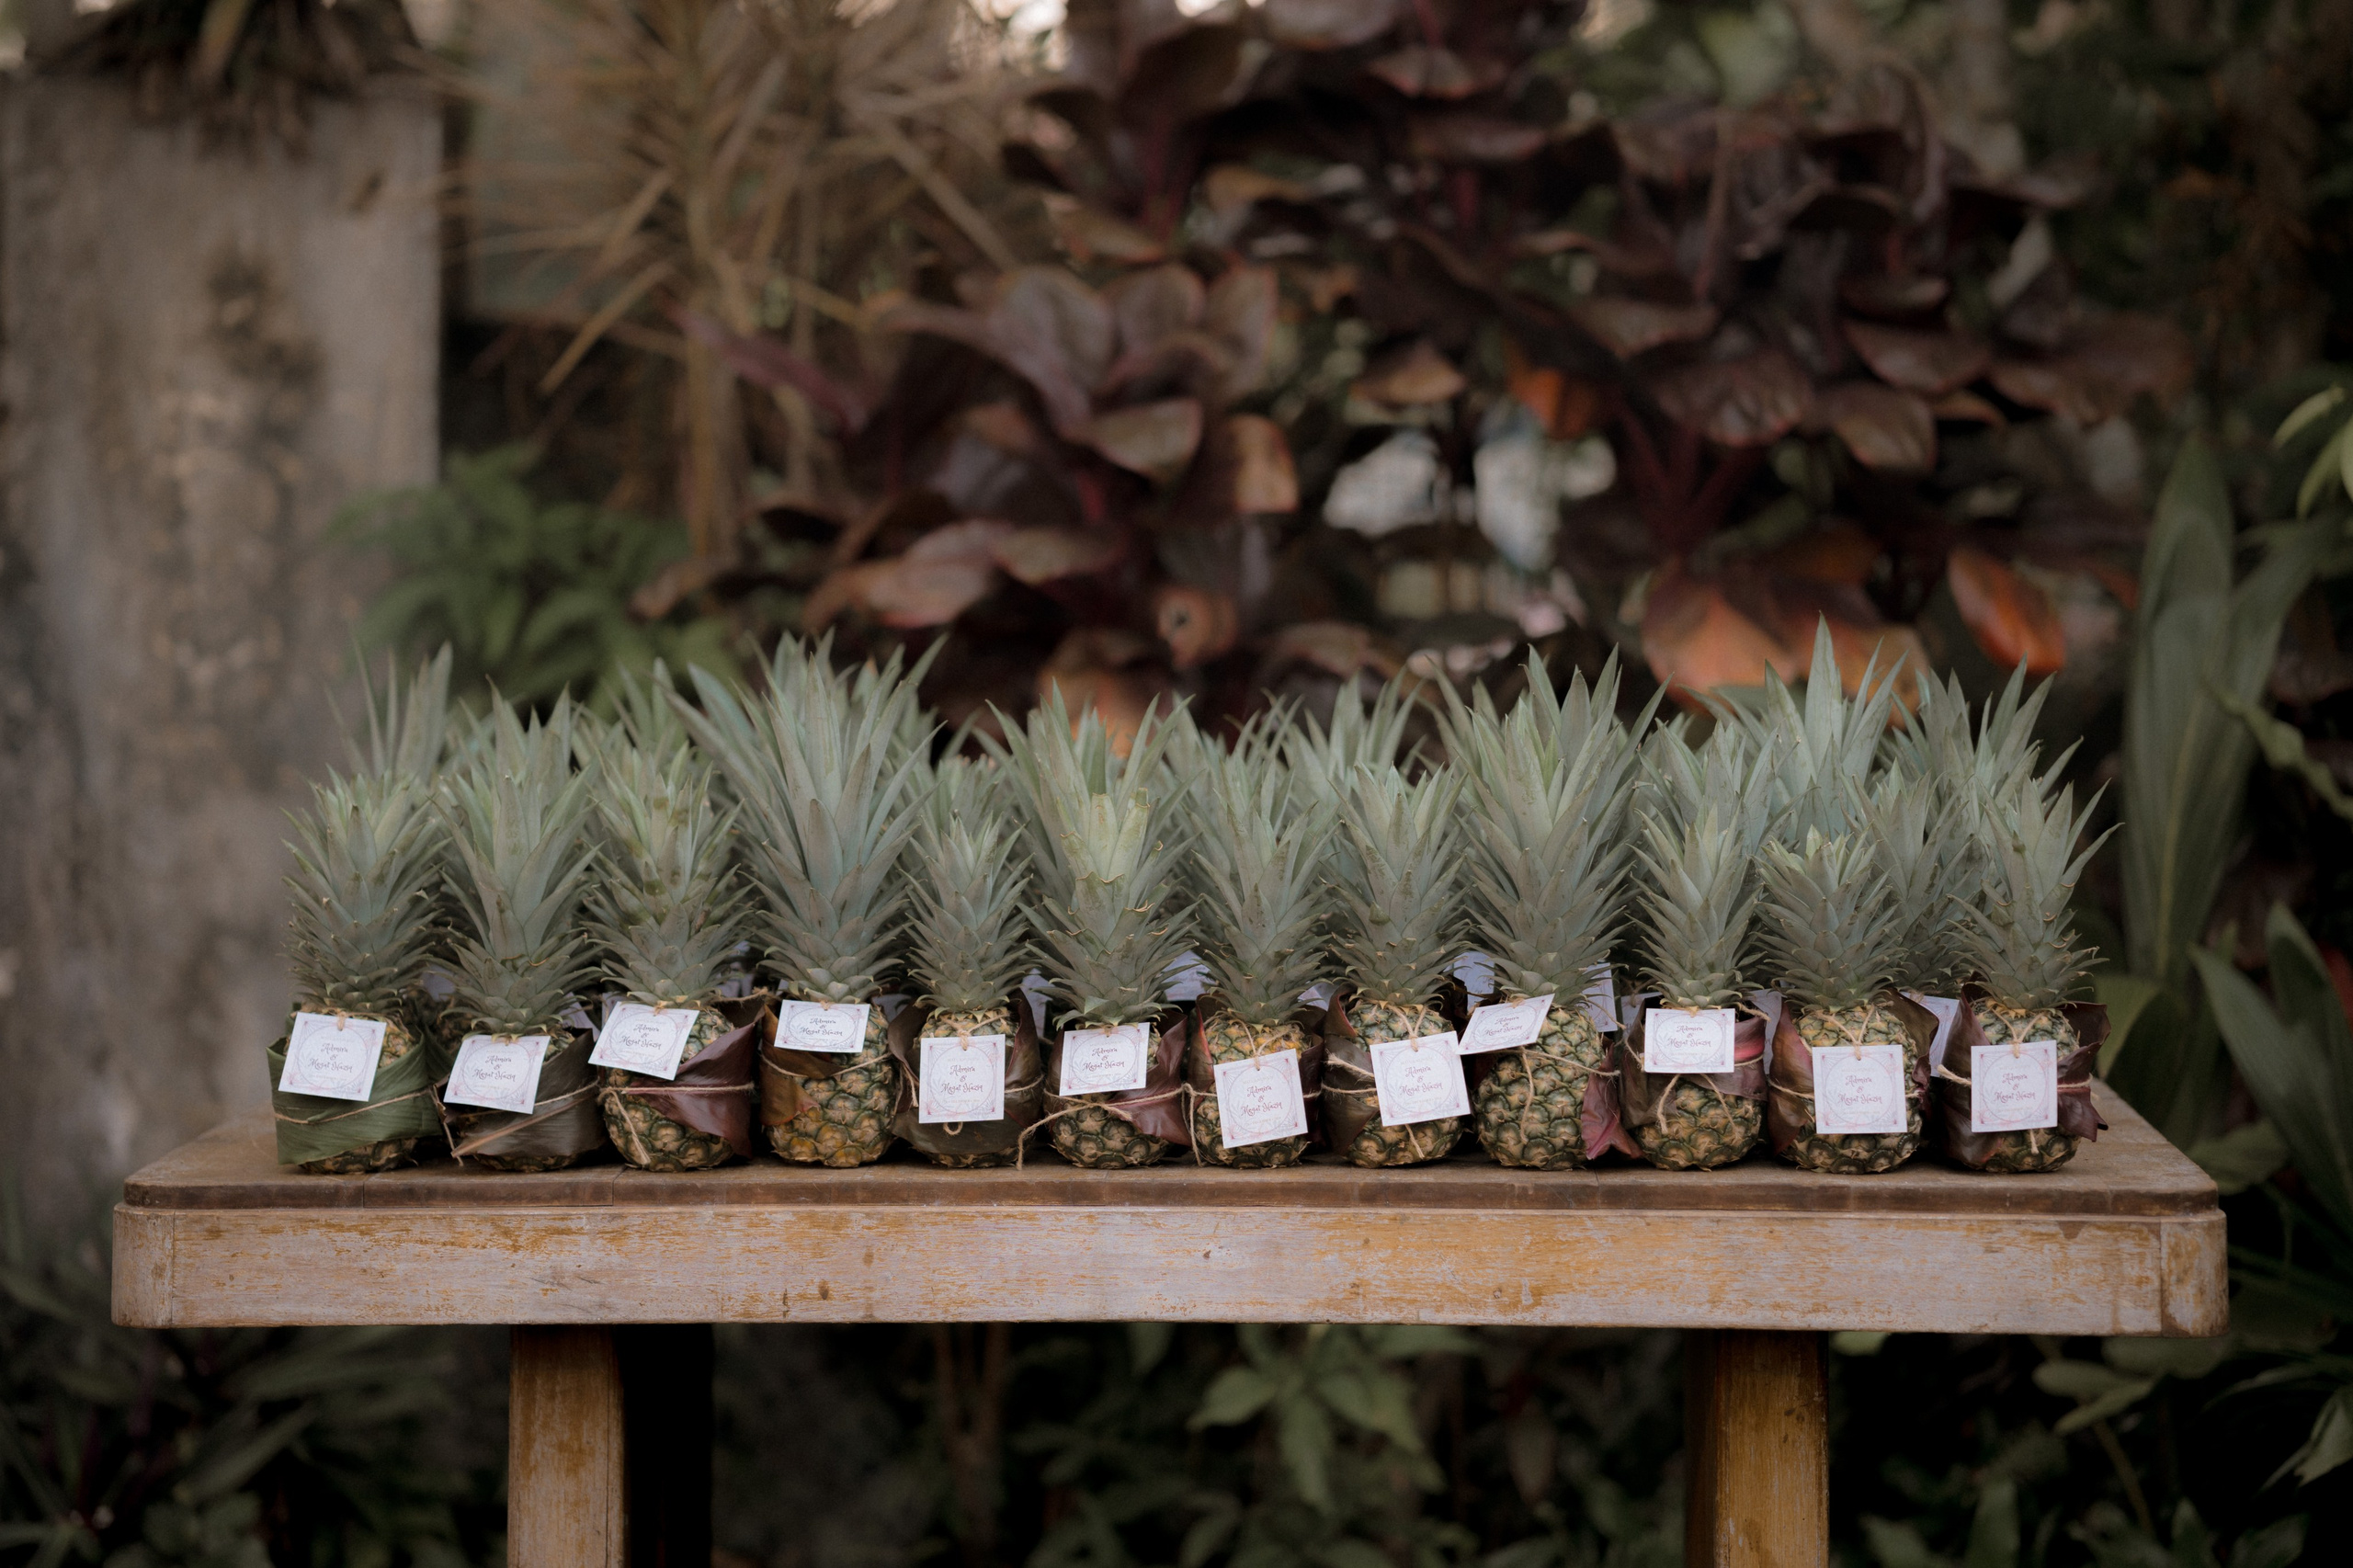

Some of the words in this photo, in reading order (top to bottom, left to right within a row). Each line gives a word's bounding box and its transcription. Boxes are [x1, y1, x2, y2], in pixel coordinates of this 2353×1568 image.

[633, 1024, 660, 1034] Admira
[321, 1043, 348, 1054] Admira
[1091, 1046, 1118, 1056] Admira
[485, 1055, 512, 1064] Admira
[949, 1064, 975, 1076] Admira
[1405, 1066, 1431, 1077] Admira
[1845, 1075, 1872, 1086] Admira
[2002, 1074, 2028, 1085] Admira
[1247, 1085, 1272, 1097] Admira
